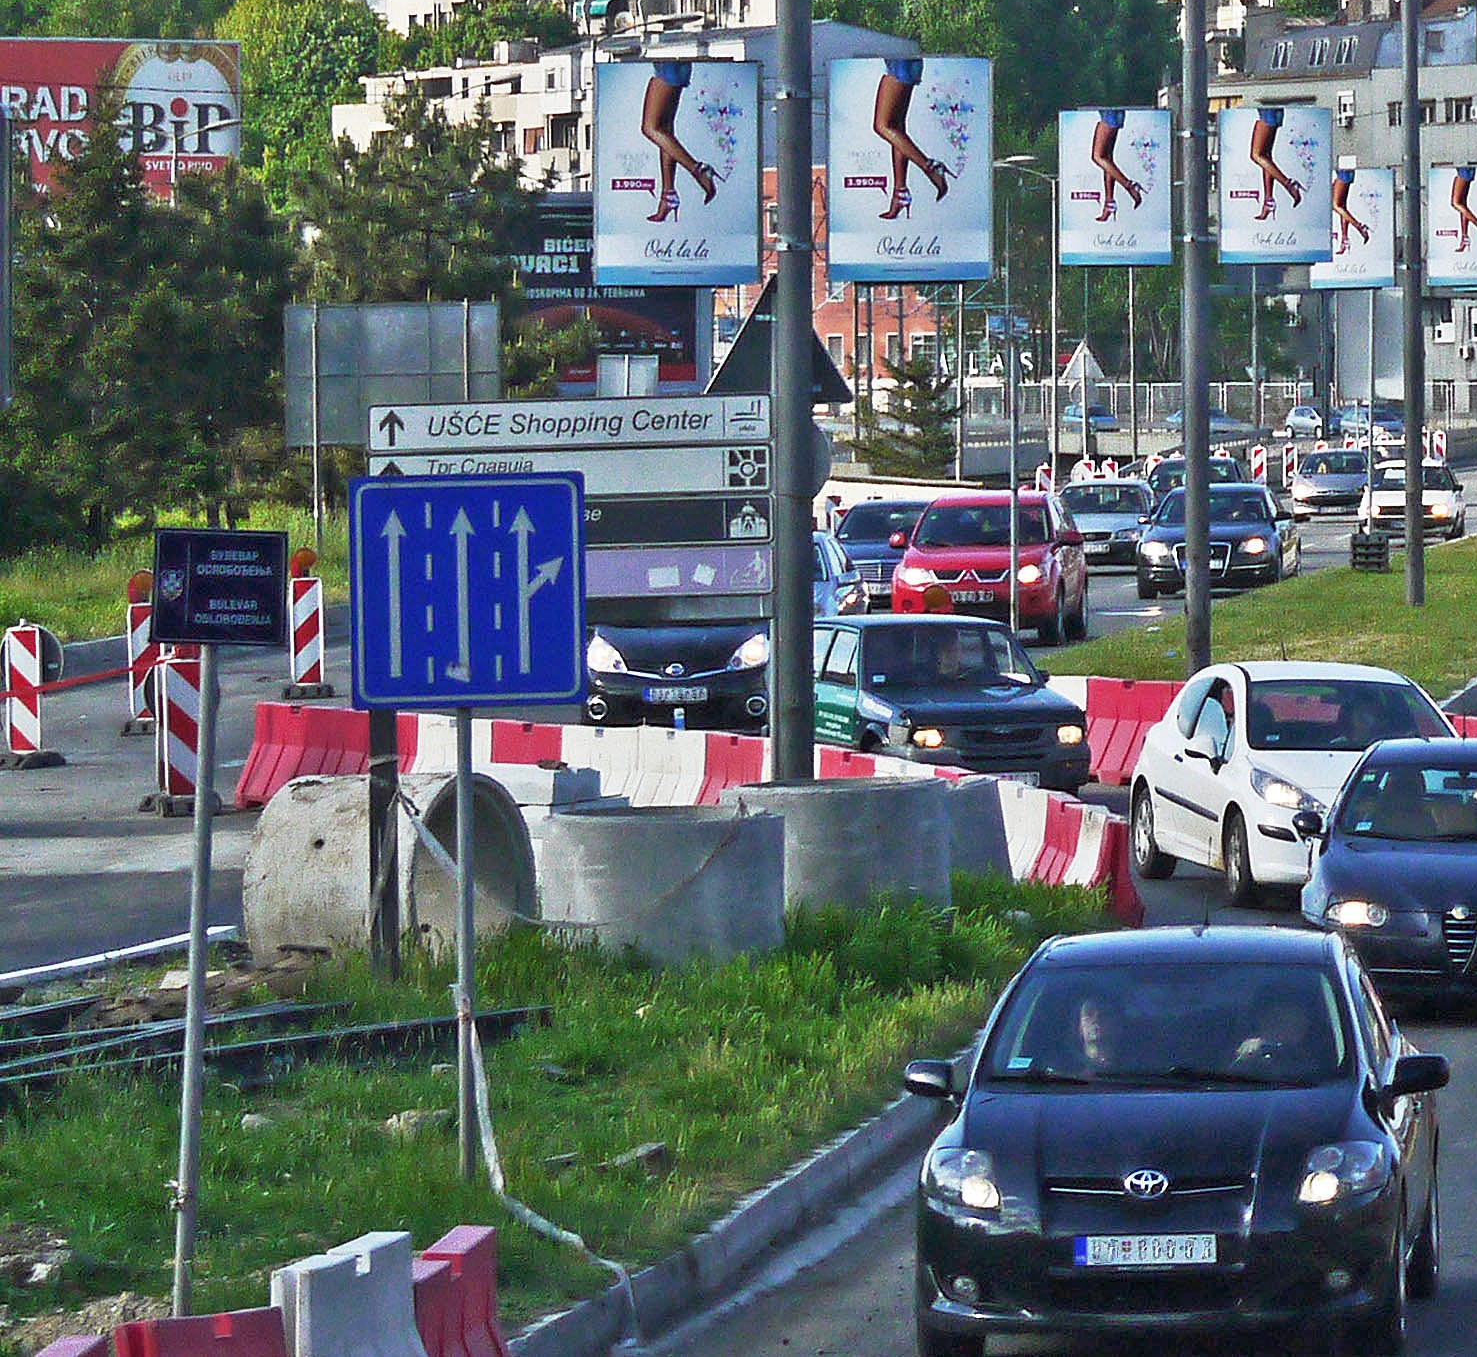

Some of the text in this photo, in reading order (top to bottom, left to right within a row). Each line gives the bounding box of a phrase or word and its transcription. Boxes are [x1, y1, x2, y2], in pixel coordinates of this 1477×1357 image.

[427, 408, 713, 439] UŠĆE Shopping Center
